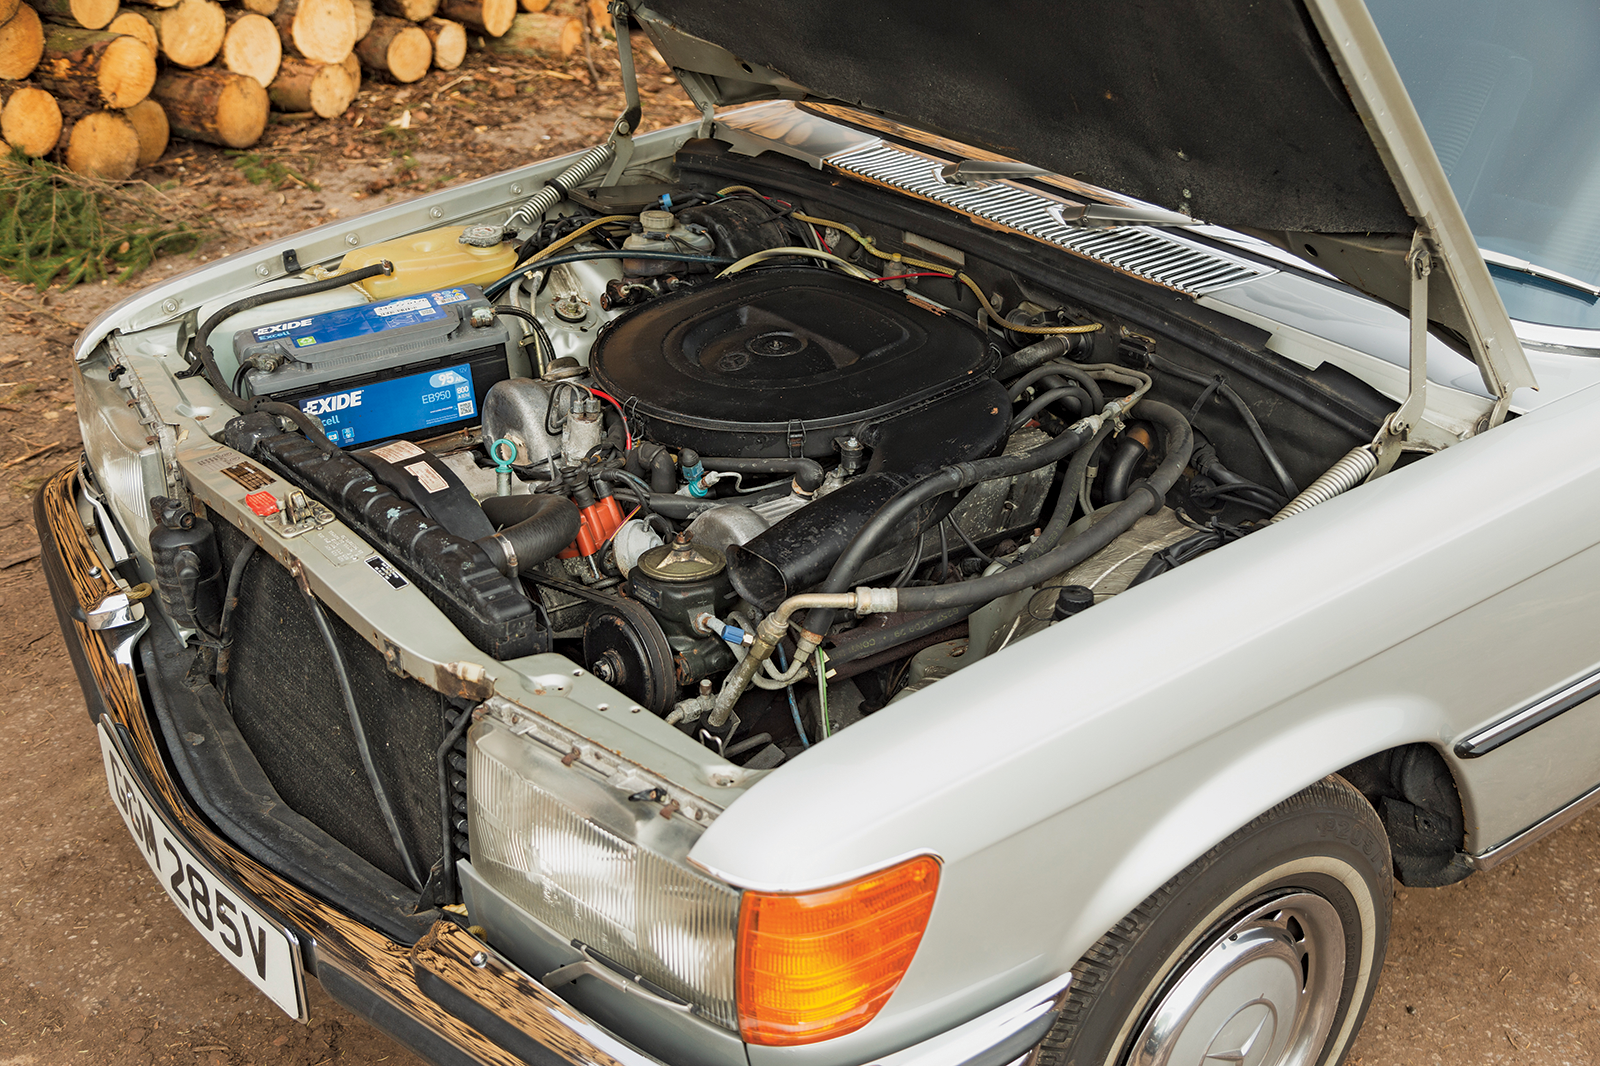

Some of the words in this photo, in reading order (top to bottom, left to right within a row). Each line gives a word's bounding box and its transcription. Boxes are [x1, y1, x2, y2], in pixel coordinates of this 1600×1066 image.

[254, 318, 312, 335] EXIDE
[259, 331, 290, 340] Excell
[438, 372, 454, 385] 95
[422, 390, 451, 404] EB950
[457, 386, 469, 394] 800
[303, 390, 362, 415] EXIDE
[321, 415, 340, 426] cell
[935, 607, 959, 623] 6257
[163, 837, 266, 981] 285V
